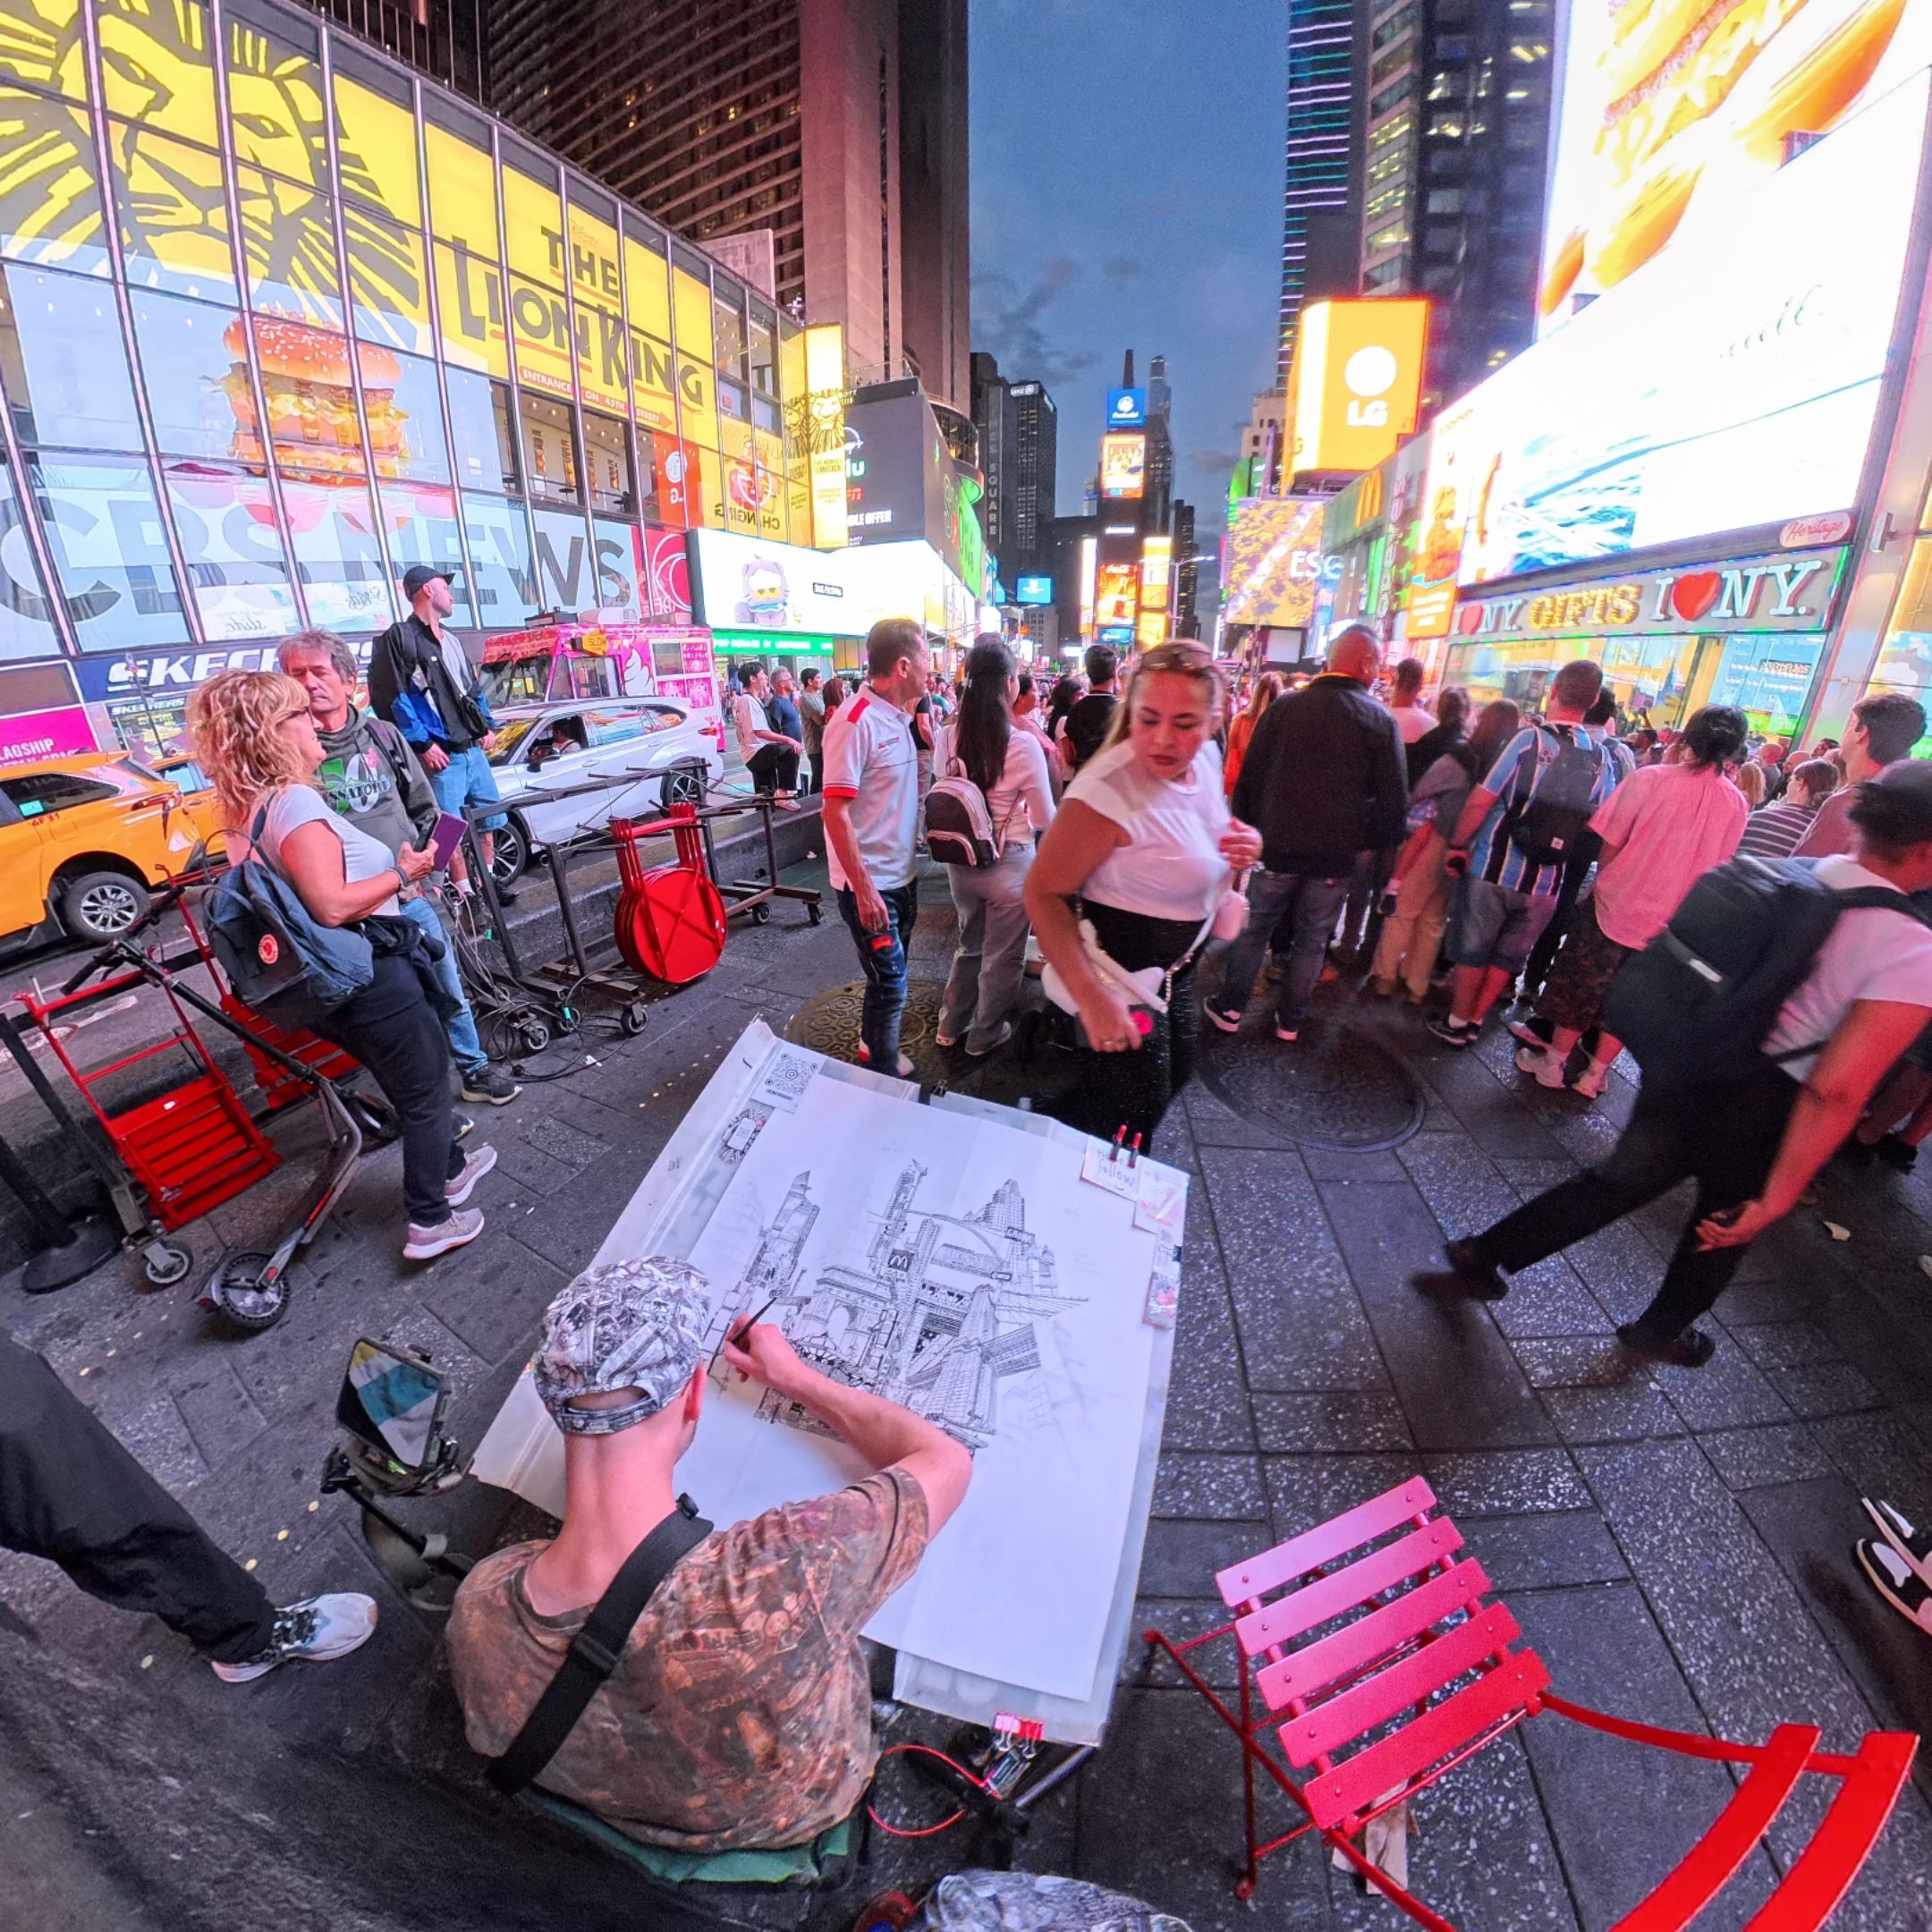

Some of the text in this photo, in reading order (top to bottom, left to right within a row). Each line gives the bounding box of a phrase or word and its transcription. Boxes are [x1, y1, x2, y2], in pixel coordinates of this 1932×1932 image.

[540, 225, 620, 299] THE
[452, 234, 705, 407] LION KING
[522, 368, 661, 424] ENTRANCE ON 45TH STREET
[1346, 400, 1388, 427] LG
[987, 463, 998, 536] SQUARE
[1787, 519, 1844, 540] Heritage
[0, 495, 631, 623] CBS NEWS
[1528, 585, 1641, 630] GIFTS
[1712, 561, 1822, 618] NY.
